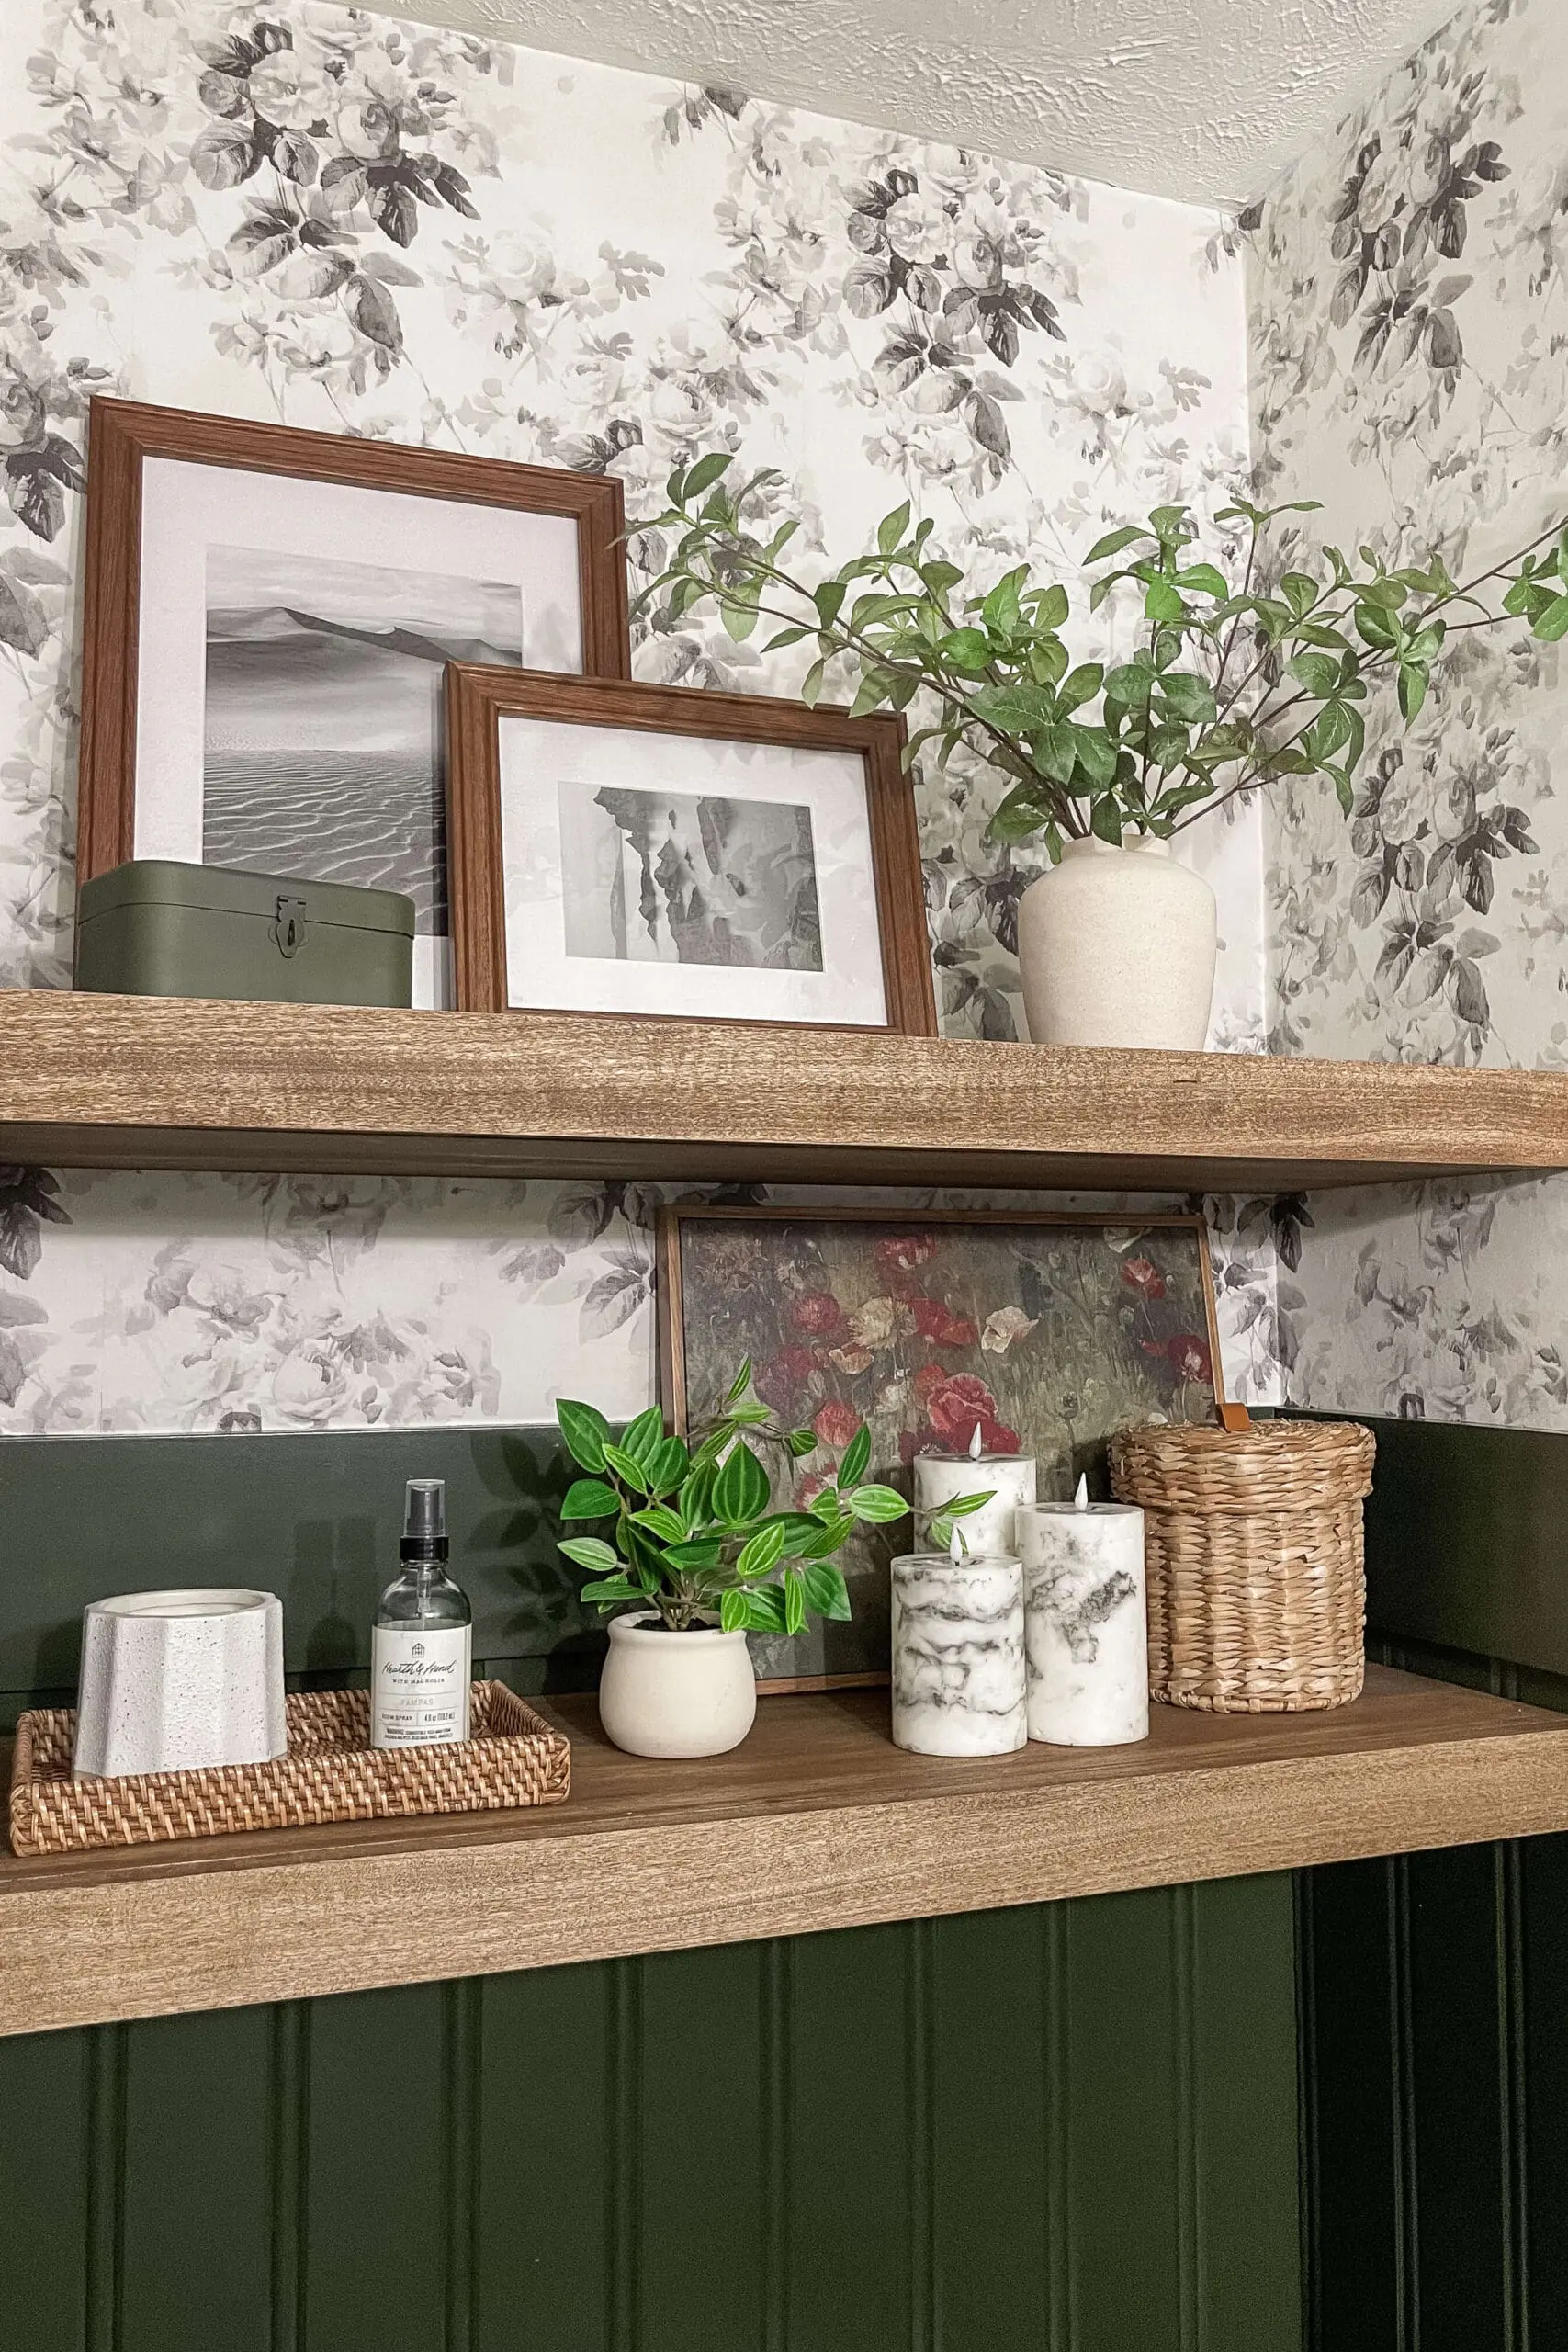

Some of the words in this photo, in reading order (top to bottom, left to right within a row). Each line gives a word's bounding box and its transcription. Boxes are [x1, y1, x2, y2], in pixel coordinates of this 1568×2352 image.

[382, 1660, 417, 1675] Hearth
[416, 1663, 424, 1675] &
[423, 1659, 457, 1675] Hand
